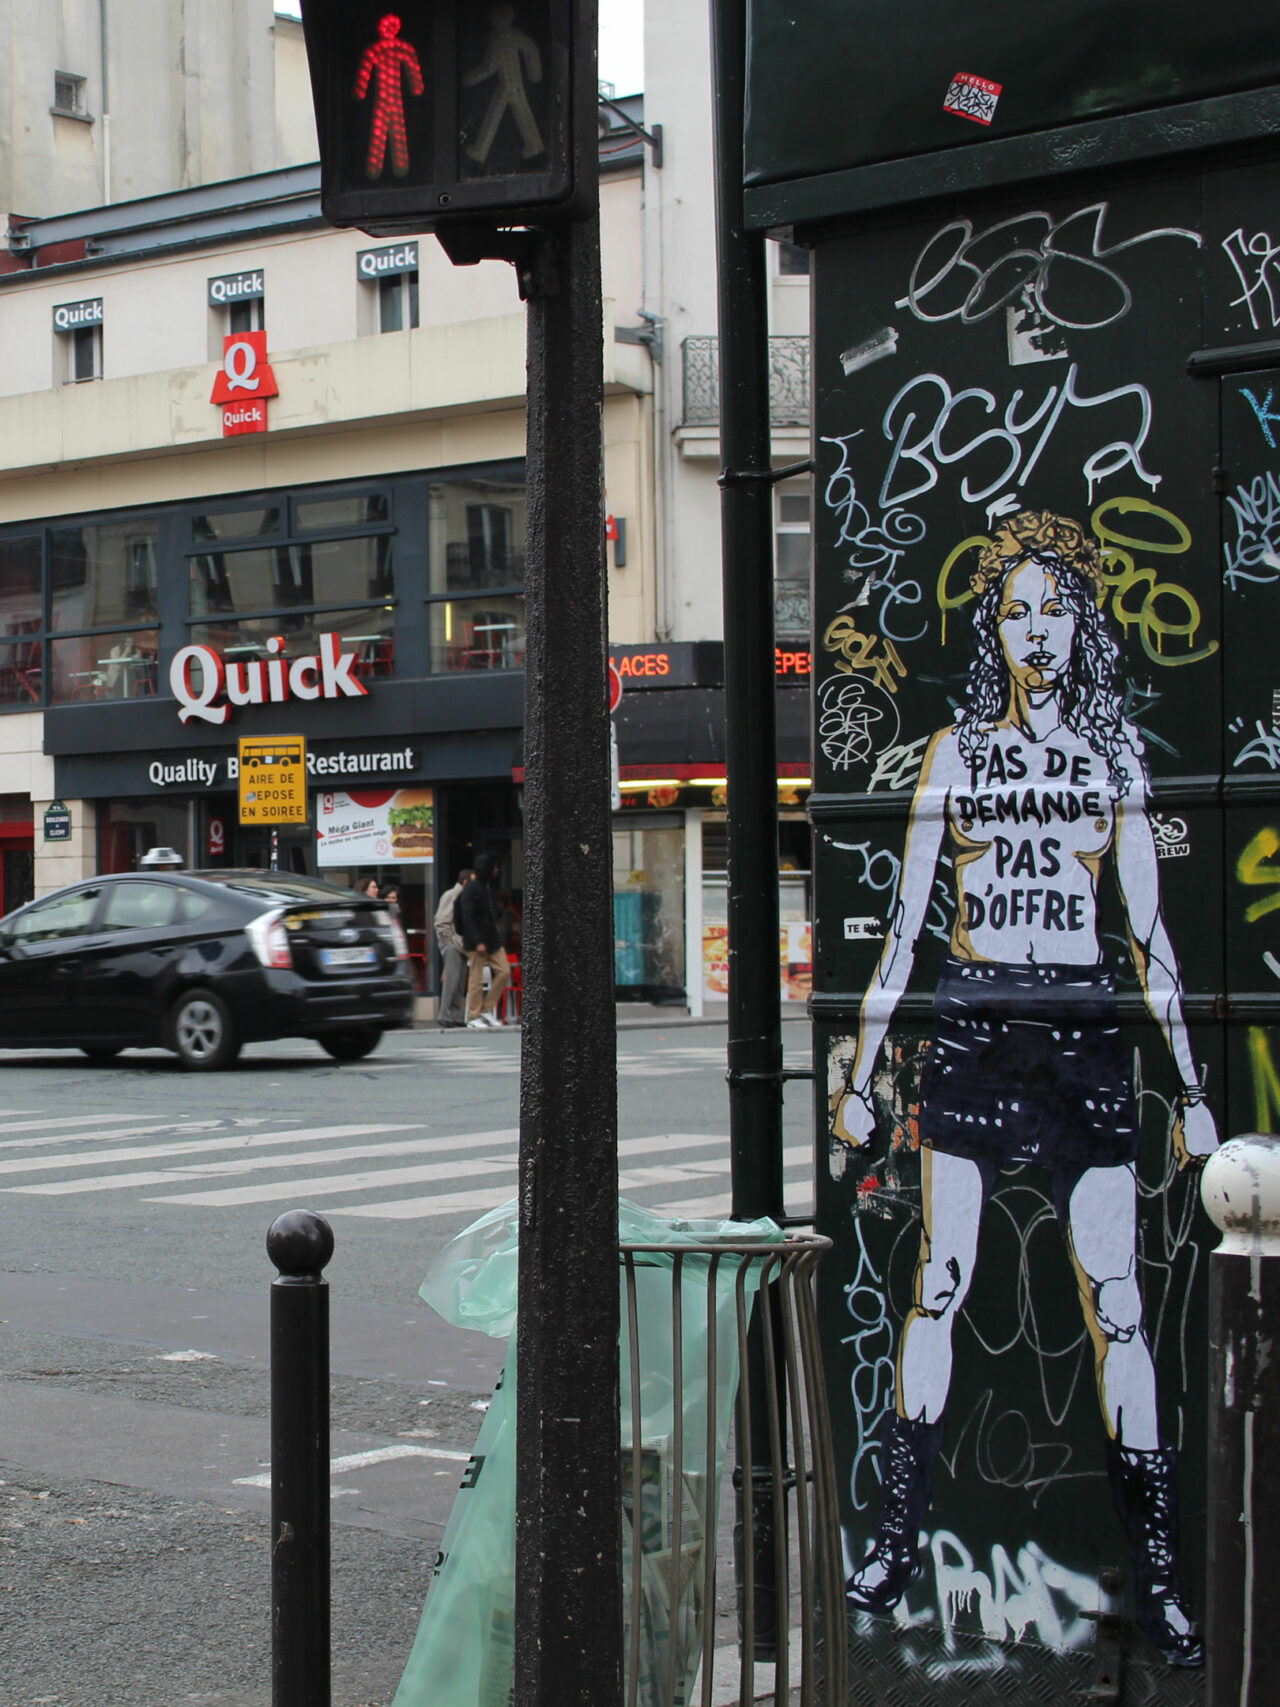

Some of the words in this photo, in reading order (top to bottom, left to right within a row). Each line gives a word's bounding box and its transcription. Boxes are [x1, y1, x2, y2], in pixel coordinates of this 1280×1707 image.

[961, 75, 995, 91] HELLO
[360, 246, 417, 275] Quick
[210, 273, 263, 302] Quick
[54, 301, 103, 328] Quick
[224, 342, 260, 392] Q
[223, 407, 262, 427] Quick
[170, 632, 368, 725] Quick
[608, 653, 670, 677] ACES
[149, 758, 218, 786] Quality
[306, 748, 414, 775] Restaurant
[248, 773, 275, 785] AIRE
[280, 773, 295, 784] DE
[969, 742, 1028, 794] PAS
[1043, 746, 1092, 786] DE
[249, 789, 295, 801] EPOSE
[955, 787, 1105, 828] DEMANDE
[241, 807, 256, 817] EN
[262, 805, 303, 817] SOIREE
[328, 823, 350, 834] Méga
[352, 819, 375, 830] Giant
[992, 835, 1061, 879] PAS
[1157, 844, 1189, 858] REW
[964, 883, 1086, 932] D'OFFRE
